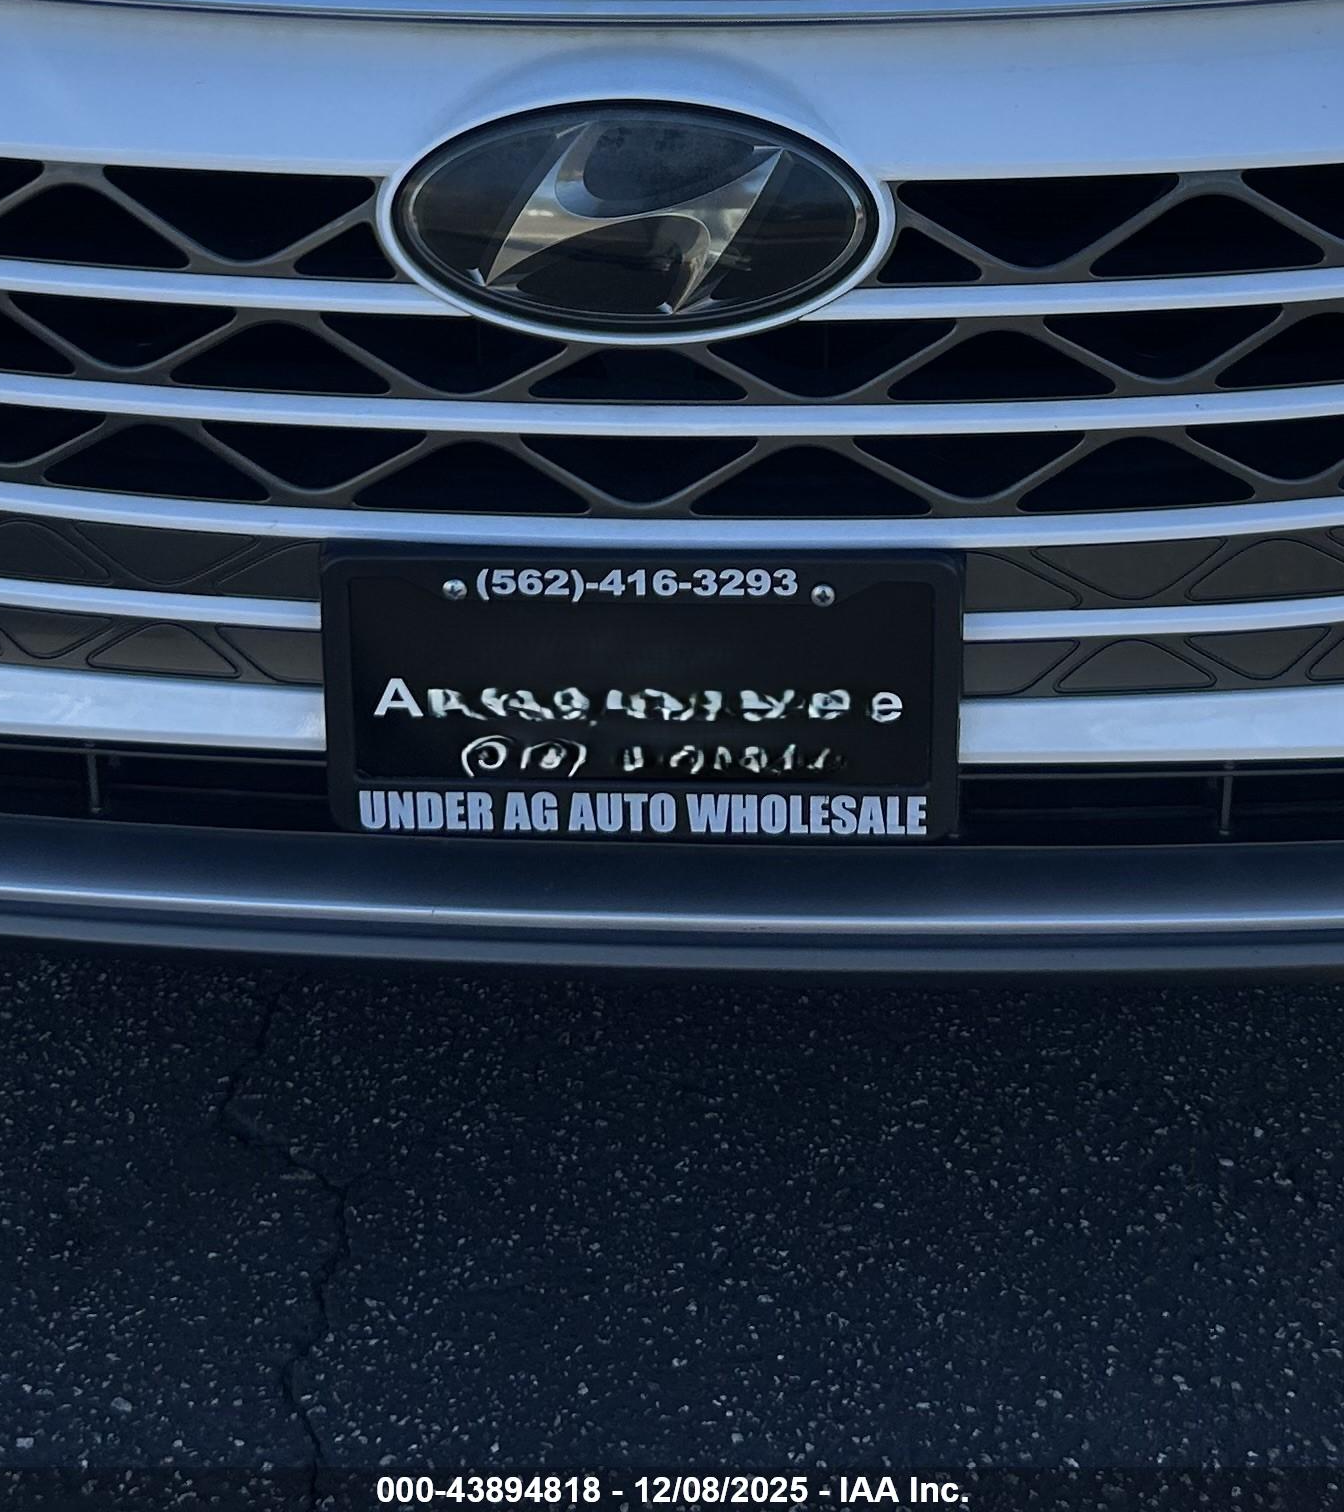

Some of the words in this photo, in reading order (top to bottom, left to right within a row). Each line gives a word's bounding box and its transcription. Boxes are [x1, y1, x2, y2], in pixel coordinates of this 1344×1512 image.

[476, 568, 799, 602] (562)-416-3293
[359, 790, 494, 831] UNDER
[504, 791, 559, 832] AG
[568, 792, 677, 834] AUTO
[686, 793, 927, 835] WHOLESALE
